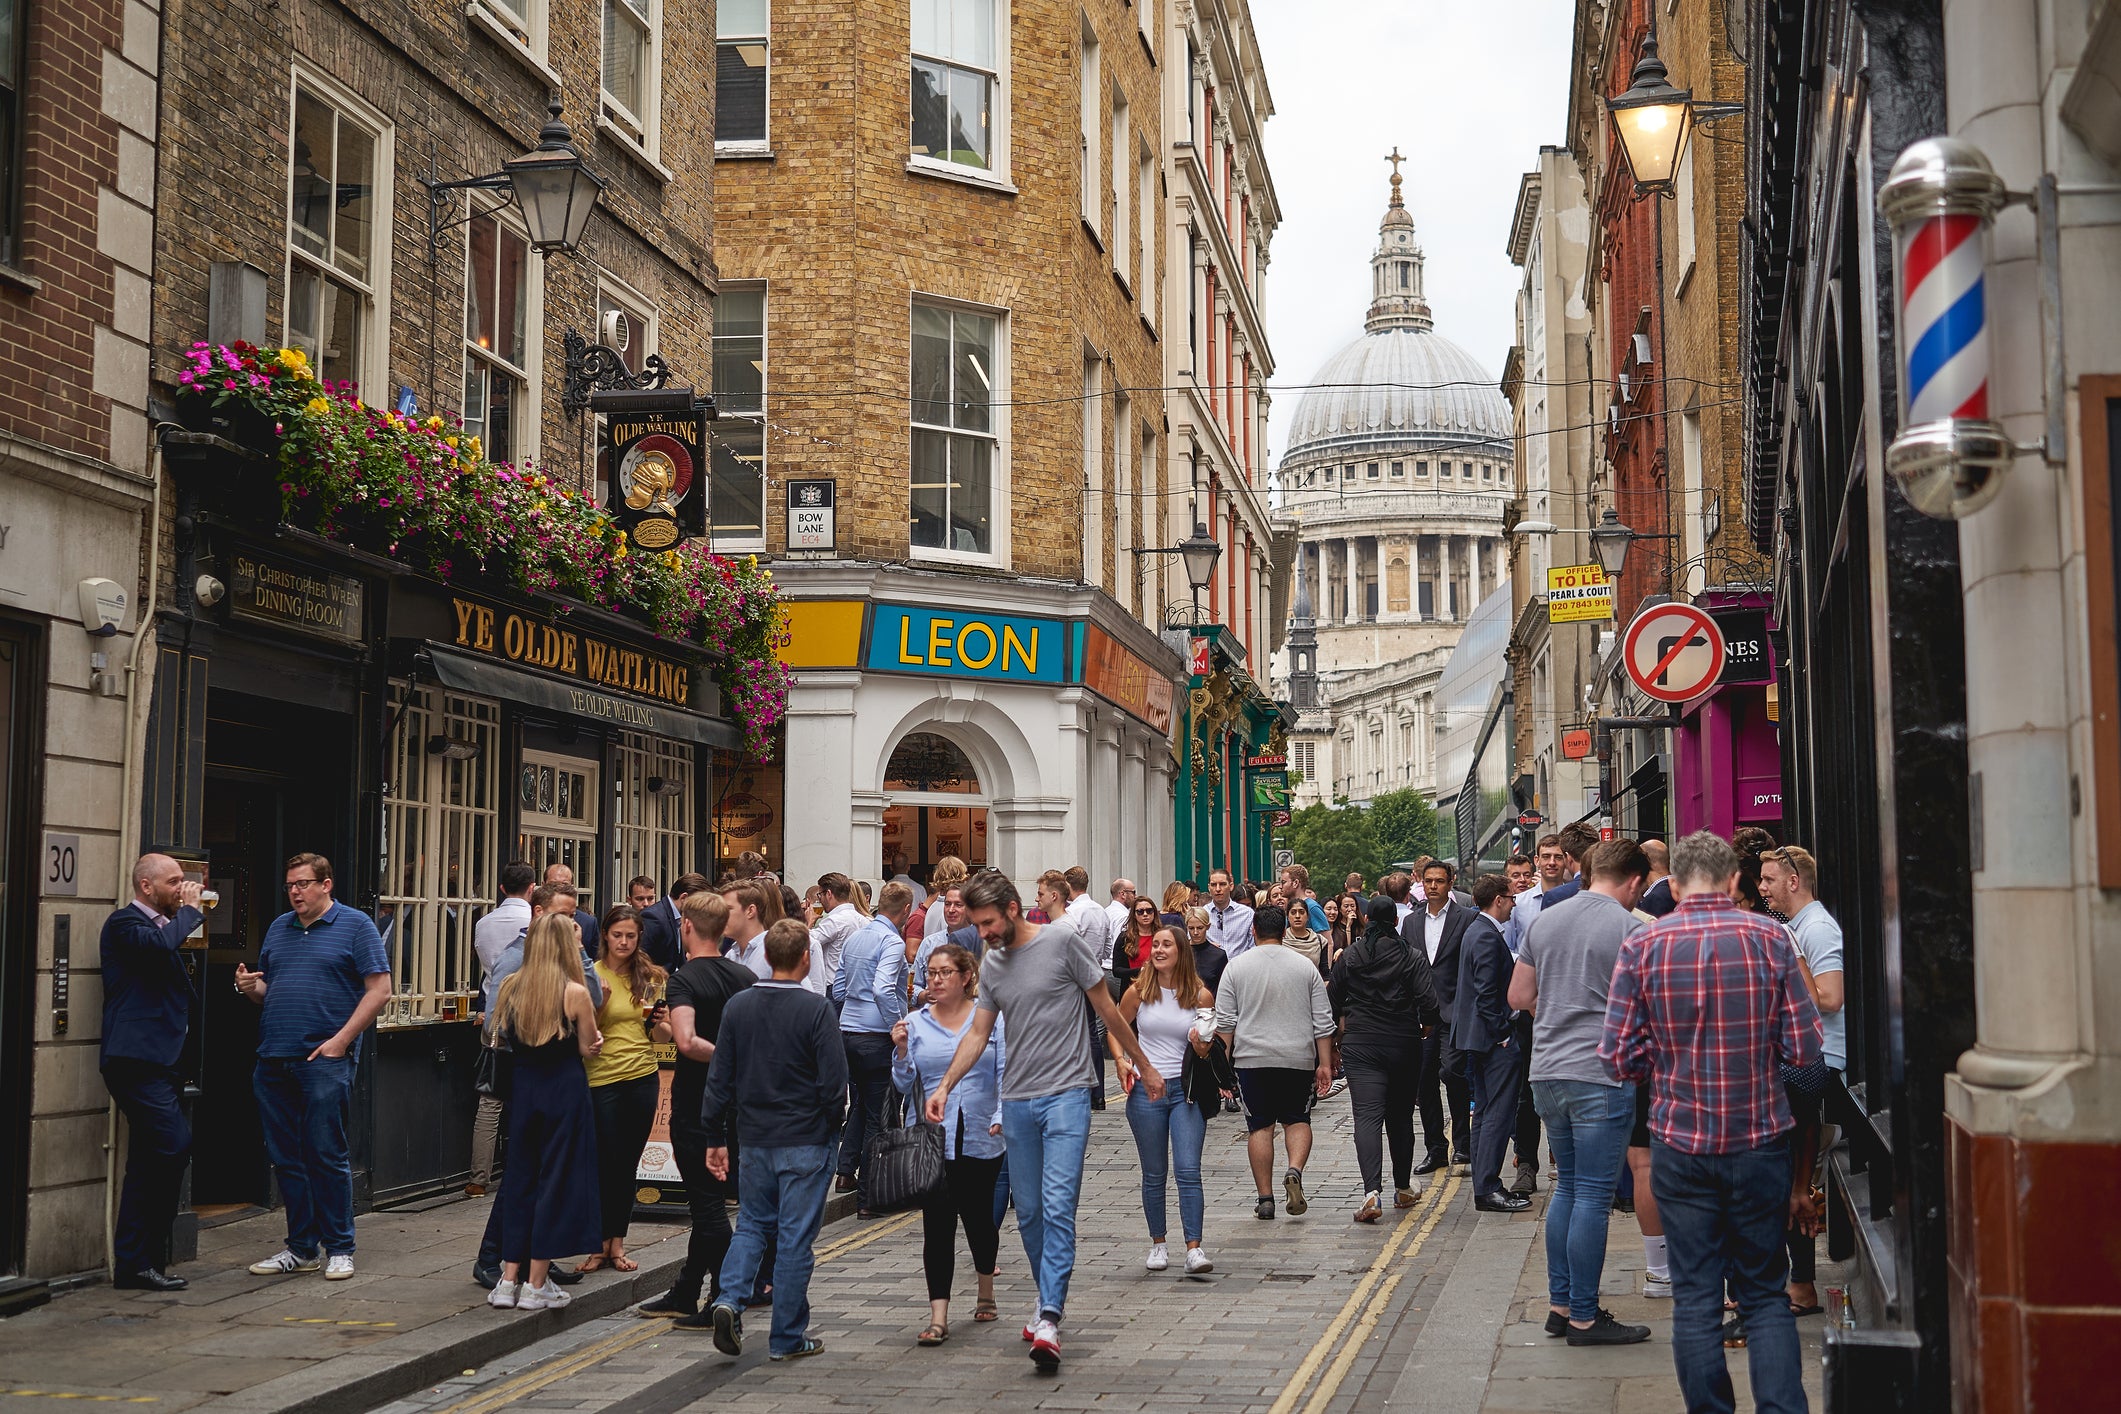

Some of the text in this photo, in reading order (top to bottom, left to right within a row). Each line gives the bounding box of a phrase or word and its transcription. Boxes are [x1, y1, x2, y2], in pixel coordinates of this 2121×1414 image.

[648, 414, 663, 422] YE
[614, 421, 697, 447] OLDE WATLING
[798, 513, 823, 522] BOW
[797, 524, 824, 533] LANE
[801, 535, 820, 544] EC4
[1566, 566, 1600, 574] OFFICES
[238, 557, 359, 607] SIR CHRISTOPHER WREN
[1555, 576, 1576, 588] TO
[1551, 590, 1576, 600] PEARL
[1578, 589, 1584, 598] &
[255, 586, 343, 628] DINING ROOM
[899, 615, 1039, 674] LEON
[453, 598, 689, 705] YE OLDE WATLING
[1119, 657, 1147, 711] LEON
[570, 691, 654, 727] YE OLDE WATLING
[1567, 740, 1588, 748] SIMPLE
[1754, 795, 1770, 807] JOY
[49, 845, 75, 883] 30
